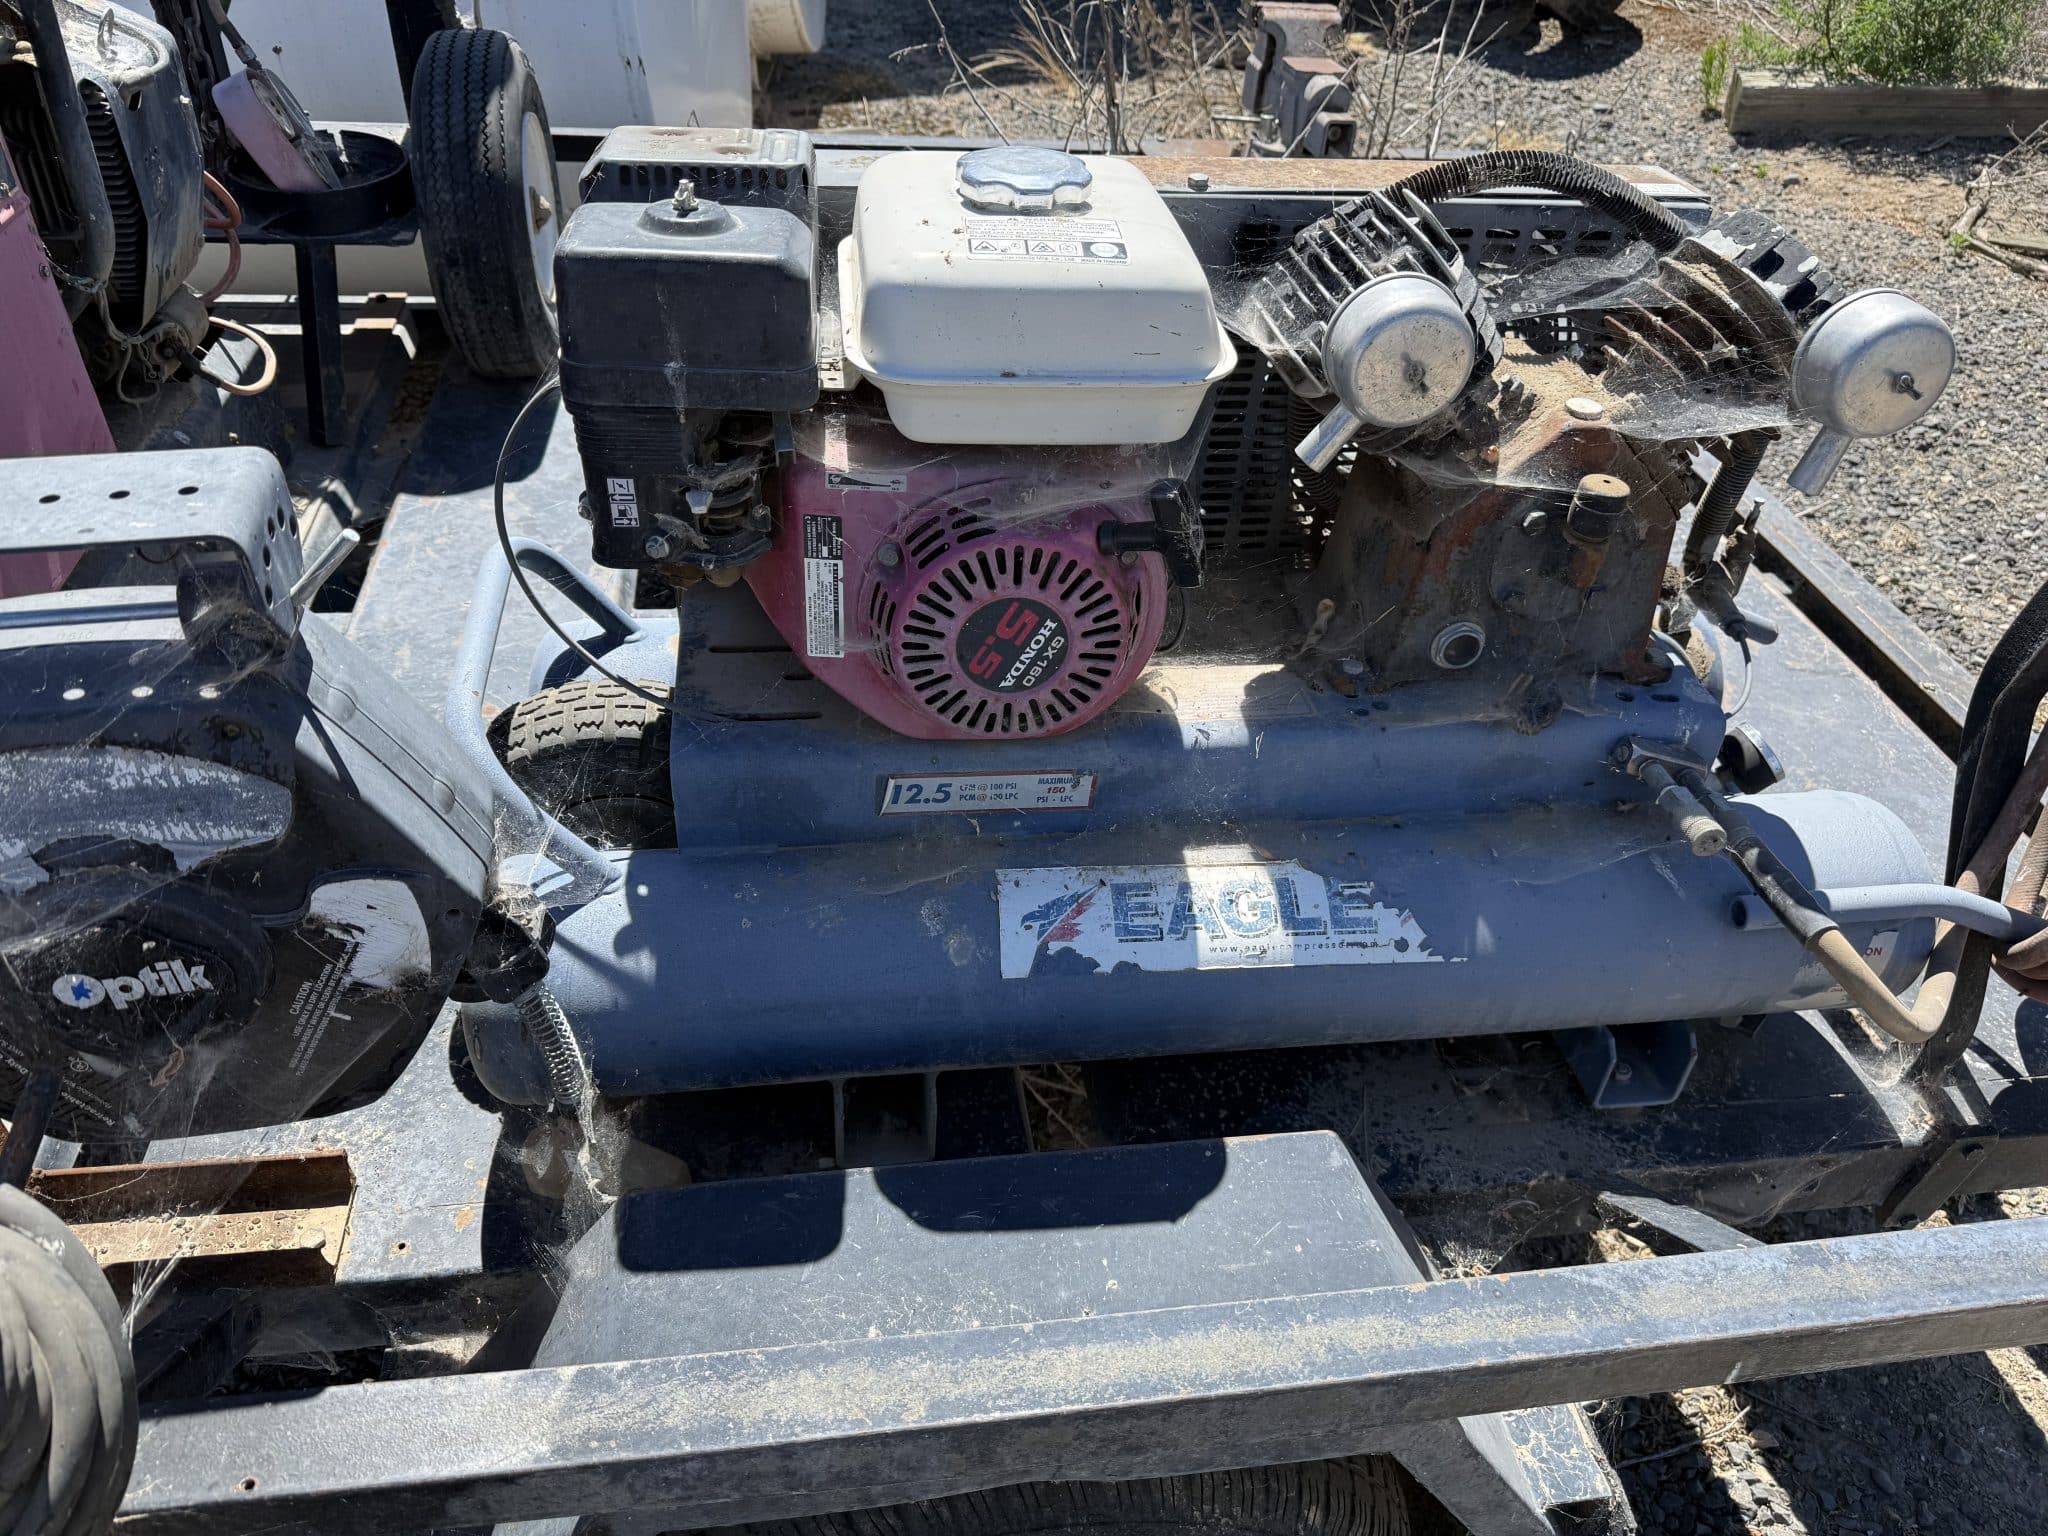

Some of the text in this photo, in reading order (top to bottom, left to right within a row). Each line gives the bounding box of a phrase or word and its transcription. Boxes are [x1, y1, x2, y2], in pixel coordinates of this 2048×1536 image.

[968, 602, 1041, 680] 5.5
[998, 618, 1058, 688] HONDA
[891, 783, 952, 805] 12.5
[960, 793, 976, 801] PCM
[1005, 792, 1019, 800] LPC
[1036, 795, 1049, 803] PSI
[1047, 786, 1066, 794] 150
[1109, 877, 1378, 943] EAGLE
[316, 963, 333, 992] LOCATION
[289, 981, 314, 1015] CAUTION
